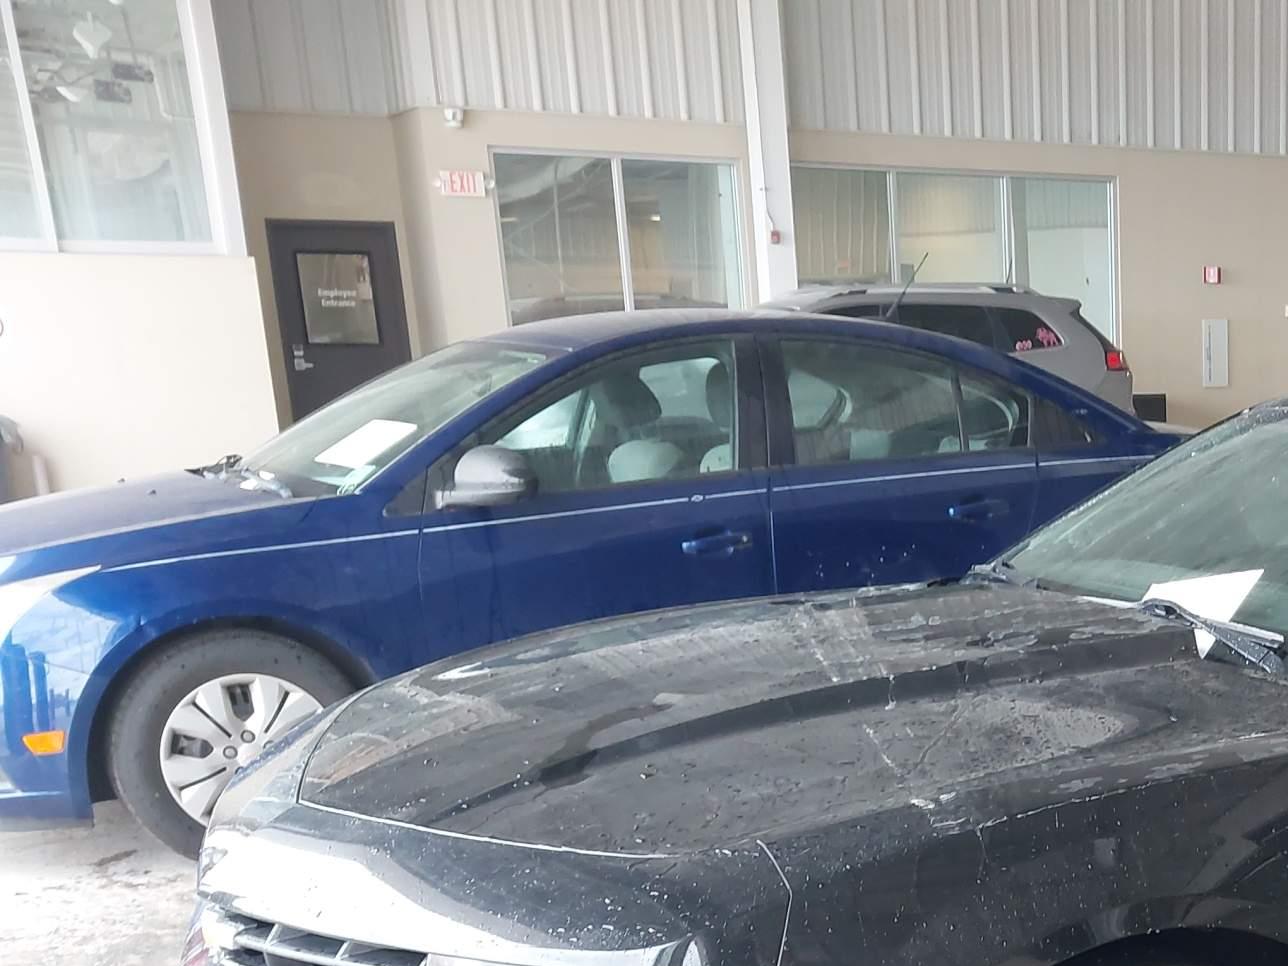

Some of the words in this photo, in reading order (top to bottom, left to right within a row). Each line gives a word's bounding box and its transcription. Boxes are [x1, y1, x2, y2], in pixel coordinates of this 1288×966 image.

[447, 170, 478, 193] EXIT
[317, 287, 357, 299] Employee
[321, 298, 356, 307] Entrance
